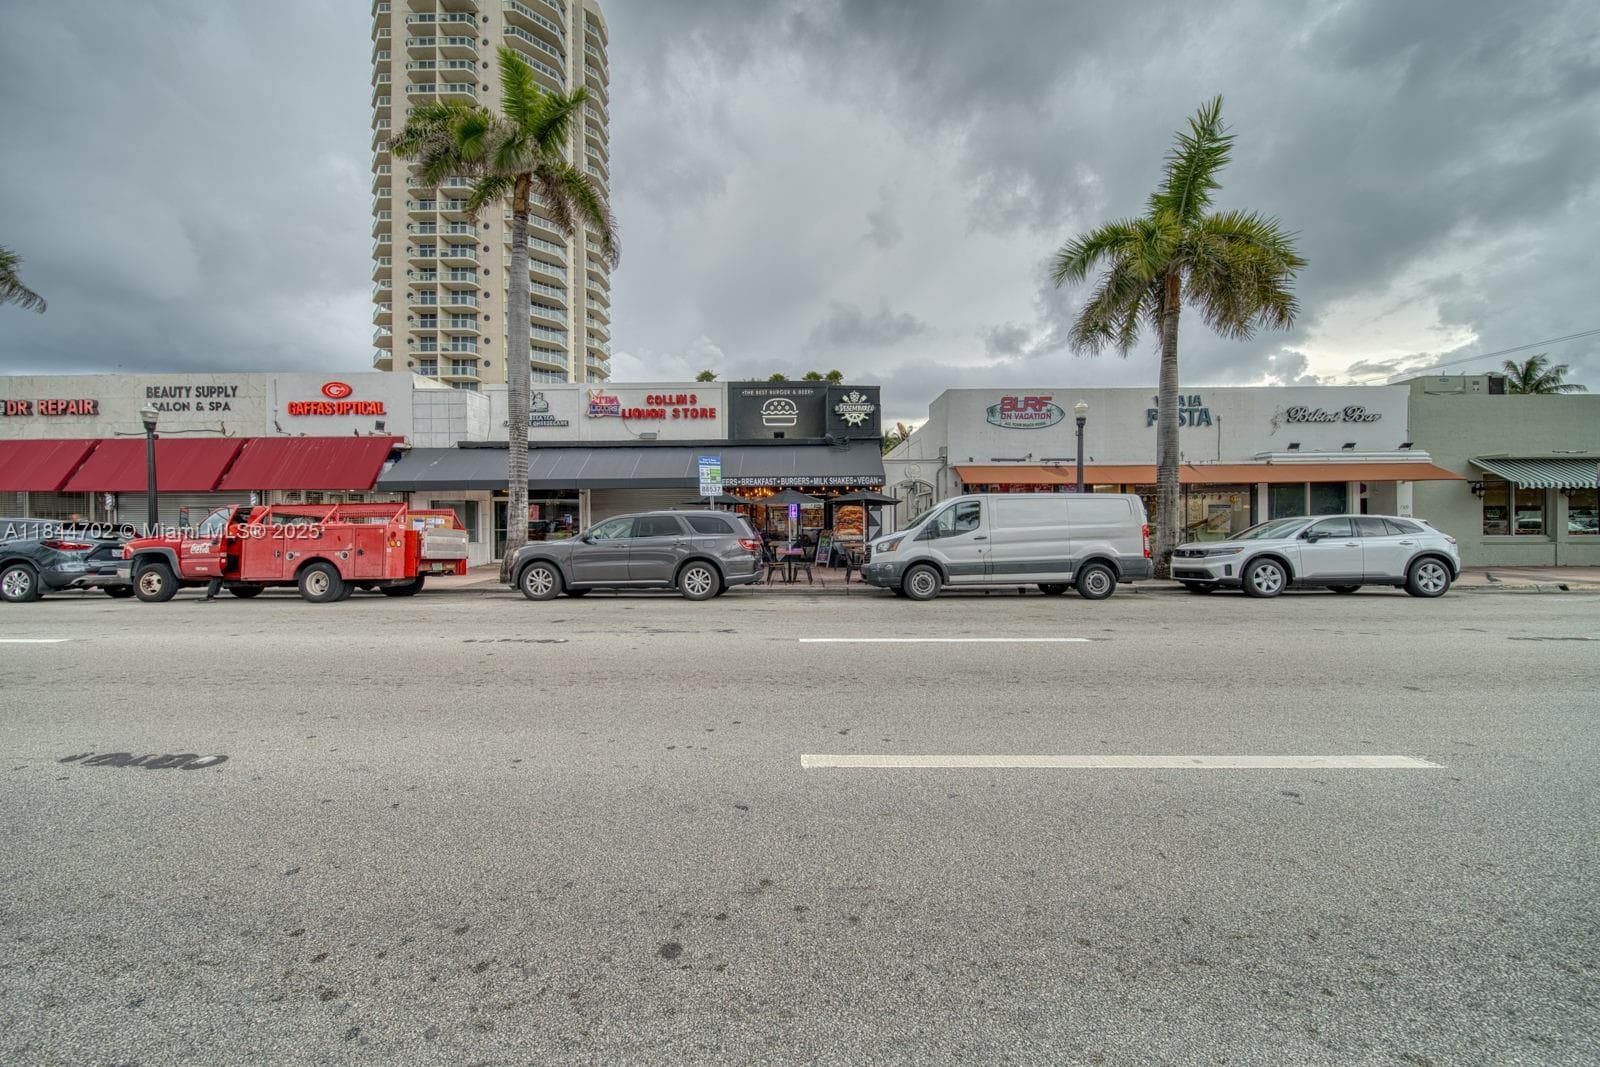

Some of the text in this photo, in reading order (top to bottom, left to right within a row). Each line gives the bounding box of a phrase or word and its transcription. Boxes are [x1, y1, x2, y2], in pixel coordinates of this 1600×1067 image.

[146, 385, 238, 398] BEAUTY SUPPLY
[152, 401, 231, 412] SALON & SPA
[646, 395, 697, 406] COLLINS
[1001, 396, 1053, 412] SURF
[1188, 394, 1202, 407] LA
[38, 399, 99, 416] REPAIR
[288, 401, 386, 416] GAFFAS OPTICAL
[622, 407, 717, 420] LIQUOR STORE
[1286, 405, 1382, 423] Bikini Bar
[1015, 412, 1052, 420] VACATION
[1146, 407, 1212, 427] FSTA
[741, 477, 777, 486] BREAKFAST
[780, 476, 809, 486] BURGERS
[813, 476, 829, 485] MILK
[829, 476, 854, 485] SHAKES
[857, 476, 878, 485] VEGAN
